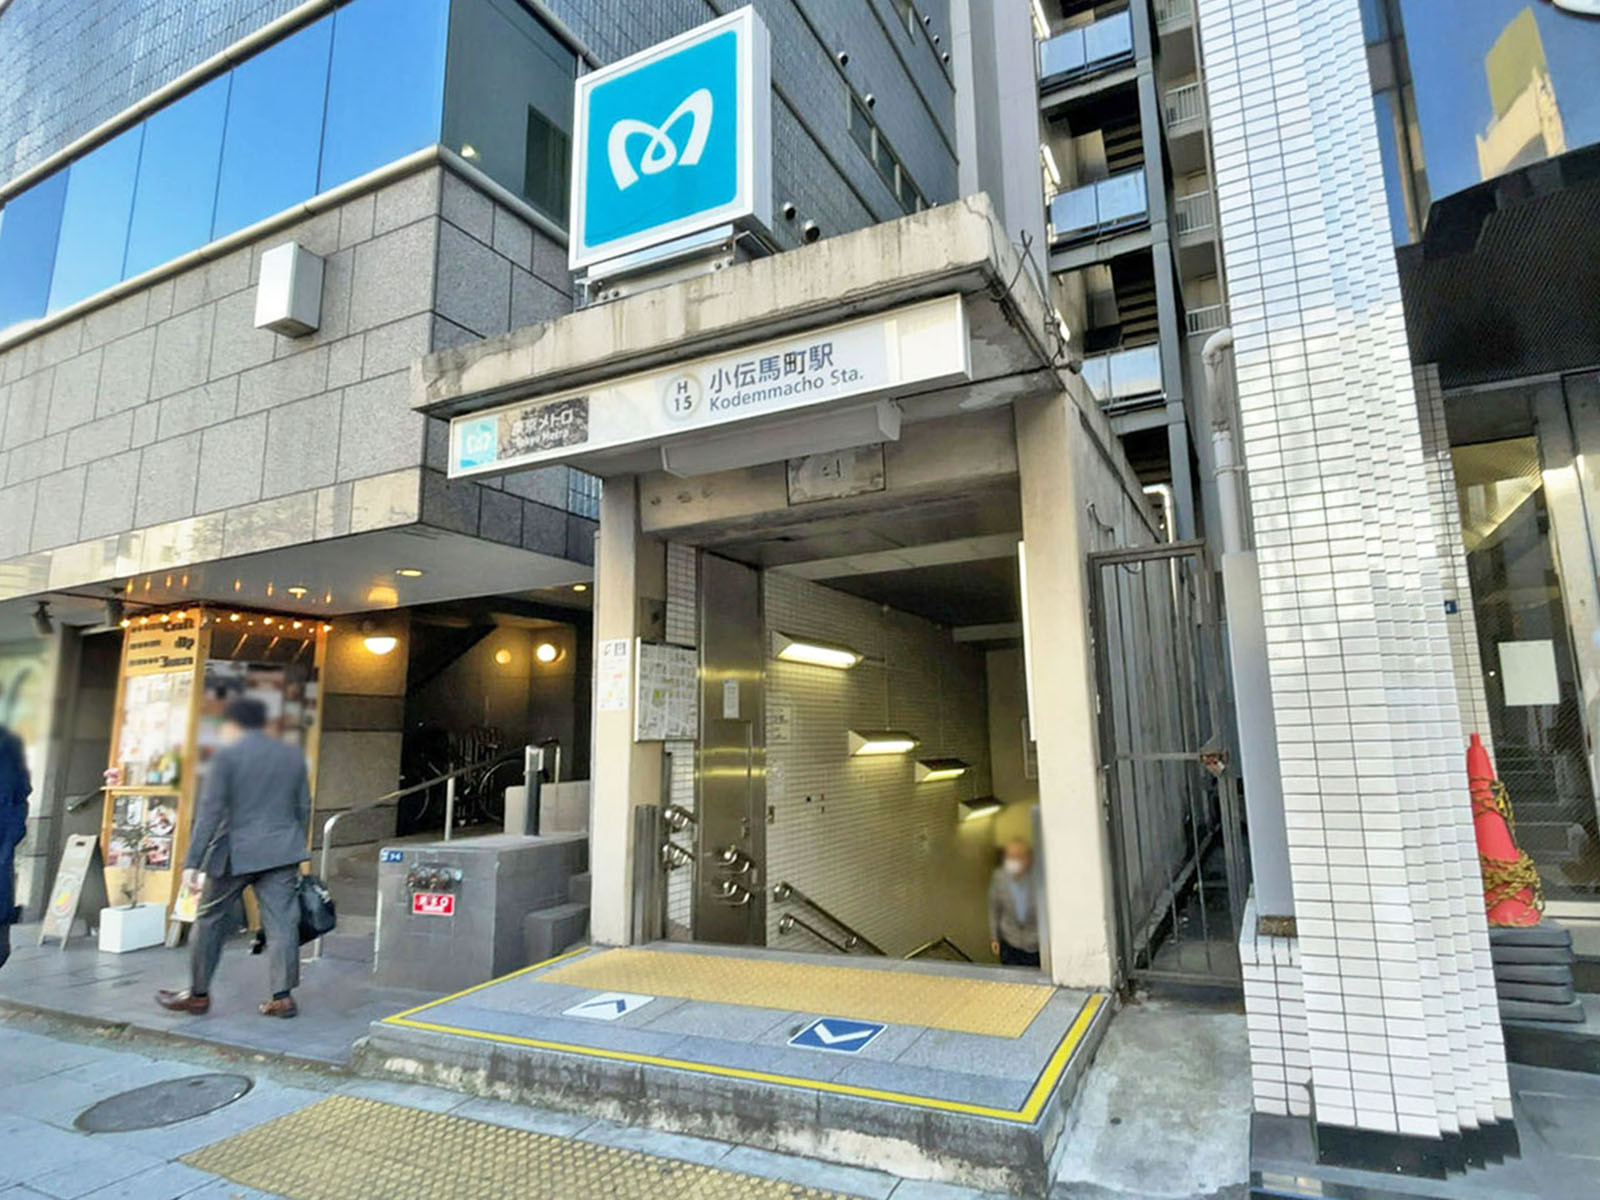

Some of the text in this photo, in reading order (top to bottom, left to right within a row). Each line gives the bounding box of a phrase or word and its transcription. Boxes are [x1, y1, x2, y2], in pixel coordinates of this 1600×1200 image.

[710, 342, 834, 394] 小伝馬町駅
[677, 381, 688, 395] H
[710, 368, 864, 411] Kodemmacho Sta.
[675, 396, 692, 411] 15
